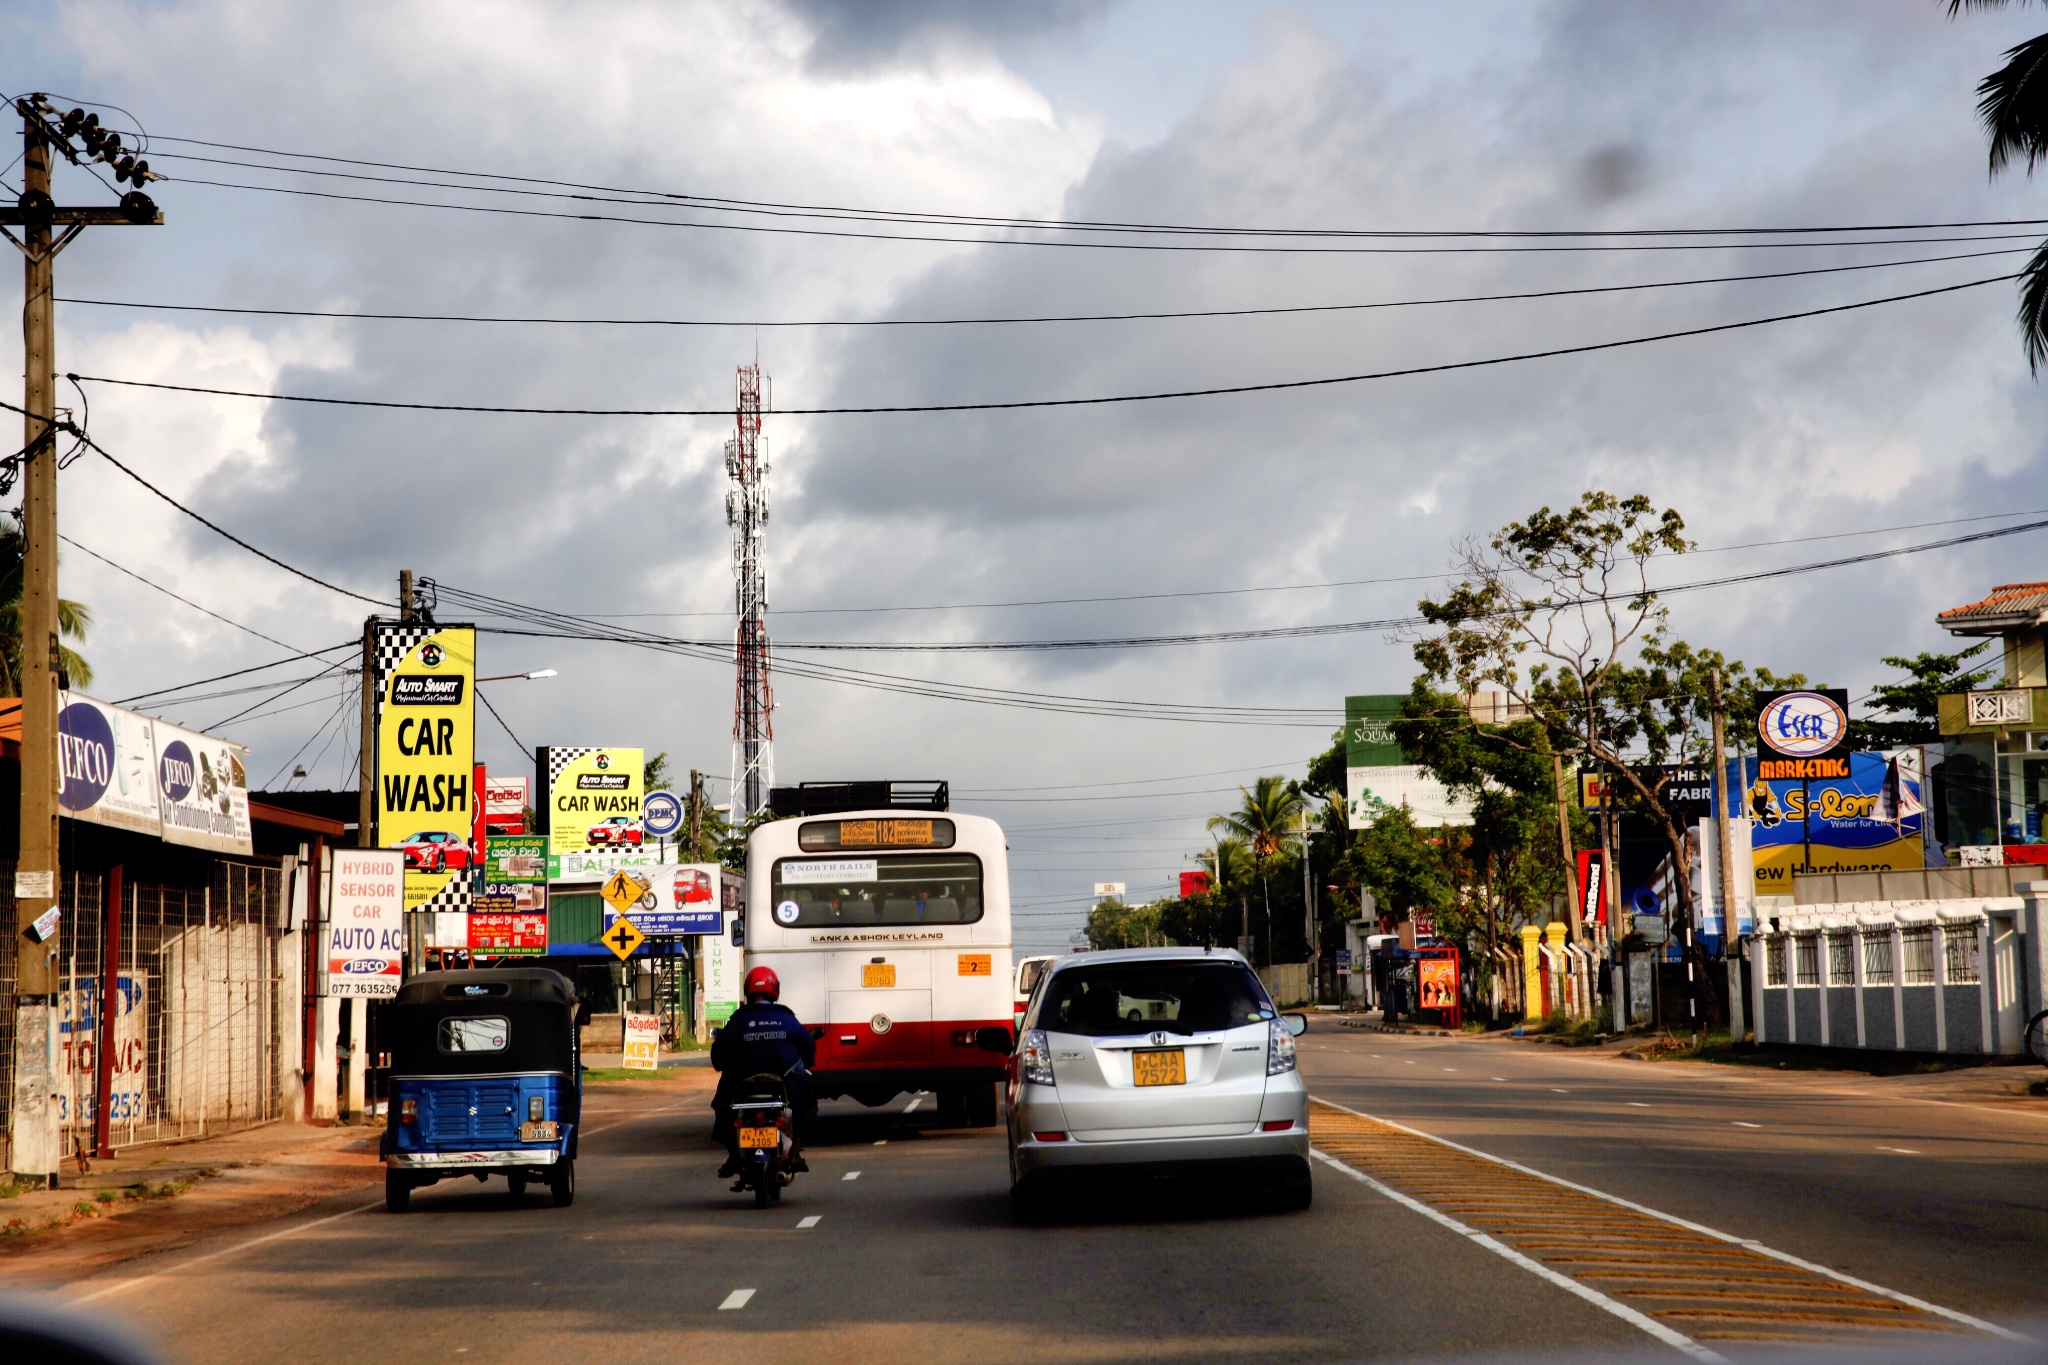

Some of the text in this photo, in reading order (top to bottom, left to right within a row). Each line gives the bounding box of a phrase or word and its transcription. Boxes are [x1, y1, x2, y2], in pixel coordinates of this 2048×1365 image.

[396, 678, 458, 692] AUTO SMART
[395, 694, 424, 703] Professional
[1778, 704, 1828, 740] ESER
[398, 718, 454, 756] CAR
[1354, 728, 1397, 744] SQUAR
[58, 732, 108, 794] JEFCO
[1760, 758, 1849, 779] MARKETING
[164, 756, 192, 794] JEFCO
[580, 775, 626, 784] AUTO SMART
[1668, 770, 1695, 782] THE
[384, 774, 468, 812] WASH
[1669, 788, 1711, 800] FABR
[558, 796, 639, 812] CAR WASH
[172, 797, 212, 834] Conditioning
[210, 806, 236, 838] Company
[648, 807, 675, 818] DPMC
[1831, 820, 1858, 828] Water
[1860, 820, 1872, 828] for
[878, 820, 894, 843] 182
[492, 847, 540, 857] යකඩ වැඩ
[342, 861, 395, 876] HYBRID
[797, 864, 837, 872] NORTH
[1756, 868, 1784, 880] ew
[340, 883, 395, 897] SENSOR
[499, 884, 519, 894] වැඩ
[353, 905, 381, 918] CAR
[784, 905, 792, 918] 5
[332, 928, 401, 950] AUTO AC
[349, 960, 385, 973] JEFCO
[712, 938, 722, 987] LUMEX
[971, 962, 977, 972] 2
[867, 976, 891, 985] 3960
[332, 984, 398, 994] 077 3635256
[744, 1031, 787, 1041] CT100
[625, 1042, 657, 1058] KEY
[1149, 1052, 1179, 1068] CAA
[1140, 1068, 1179, 1084] 7572
[754, 1128, 764, 1137] TK
[751, 1138, 772, 1147] 1105
